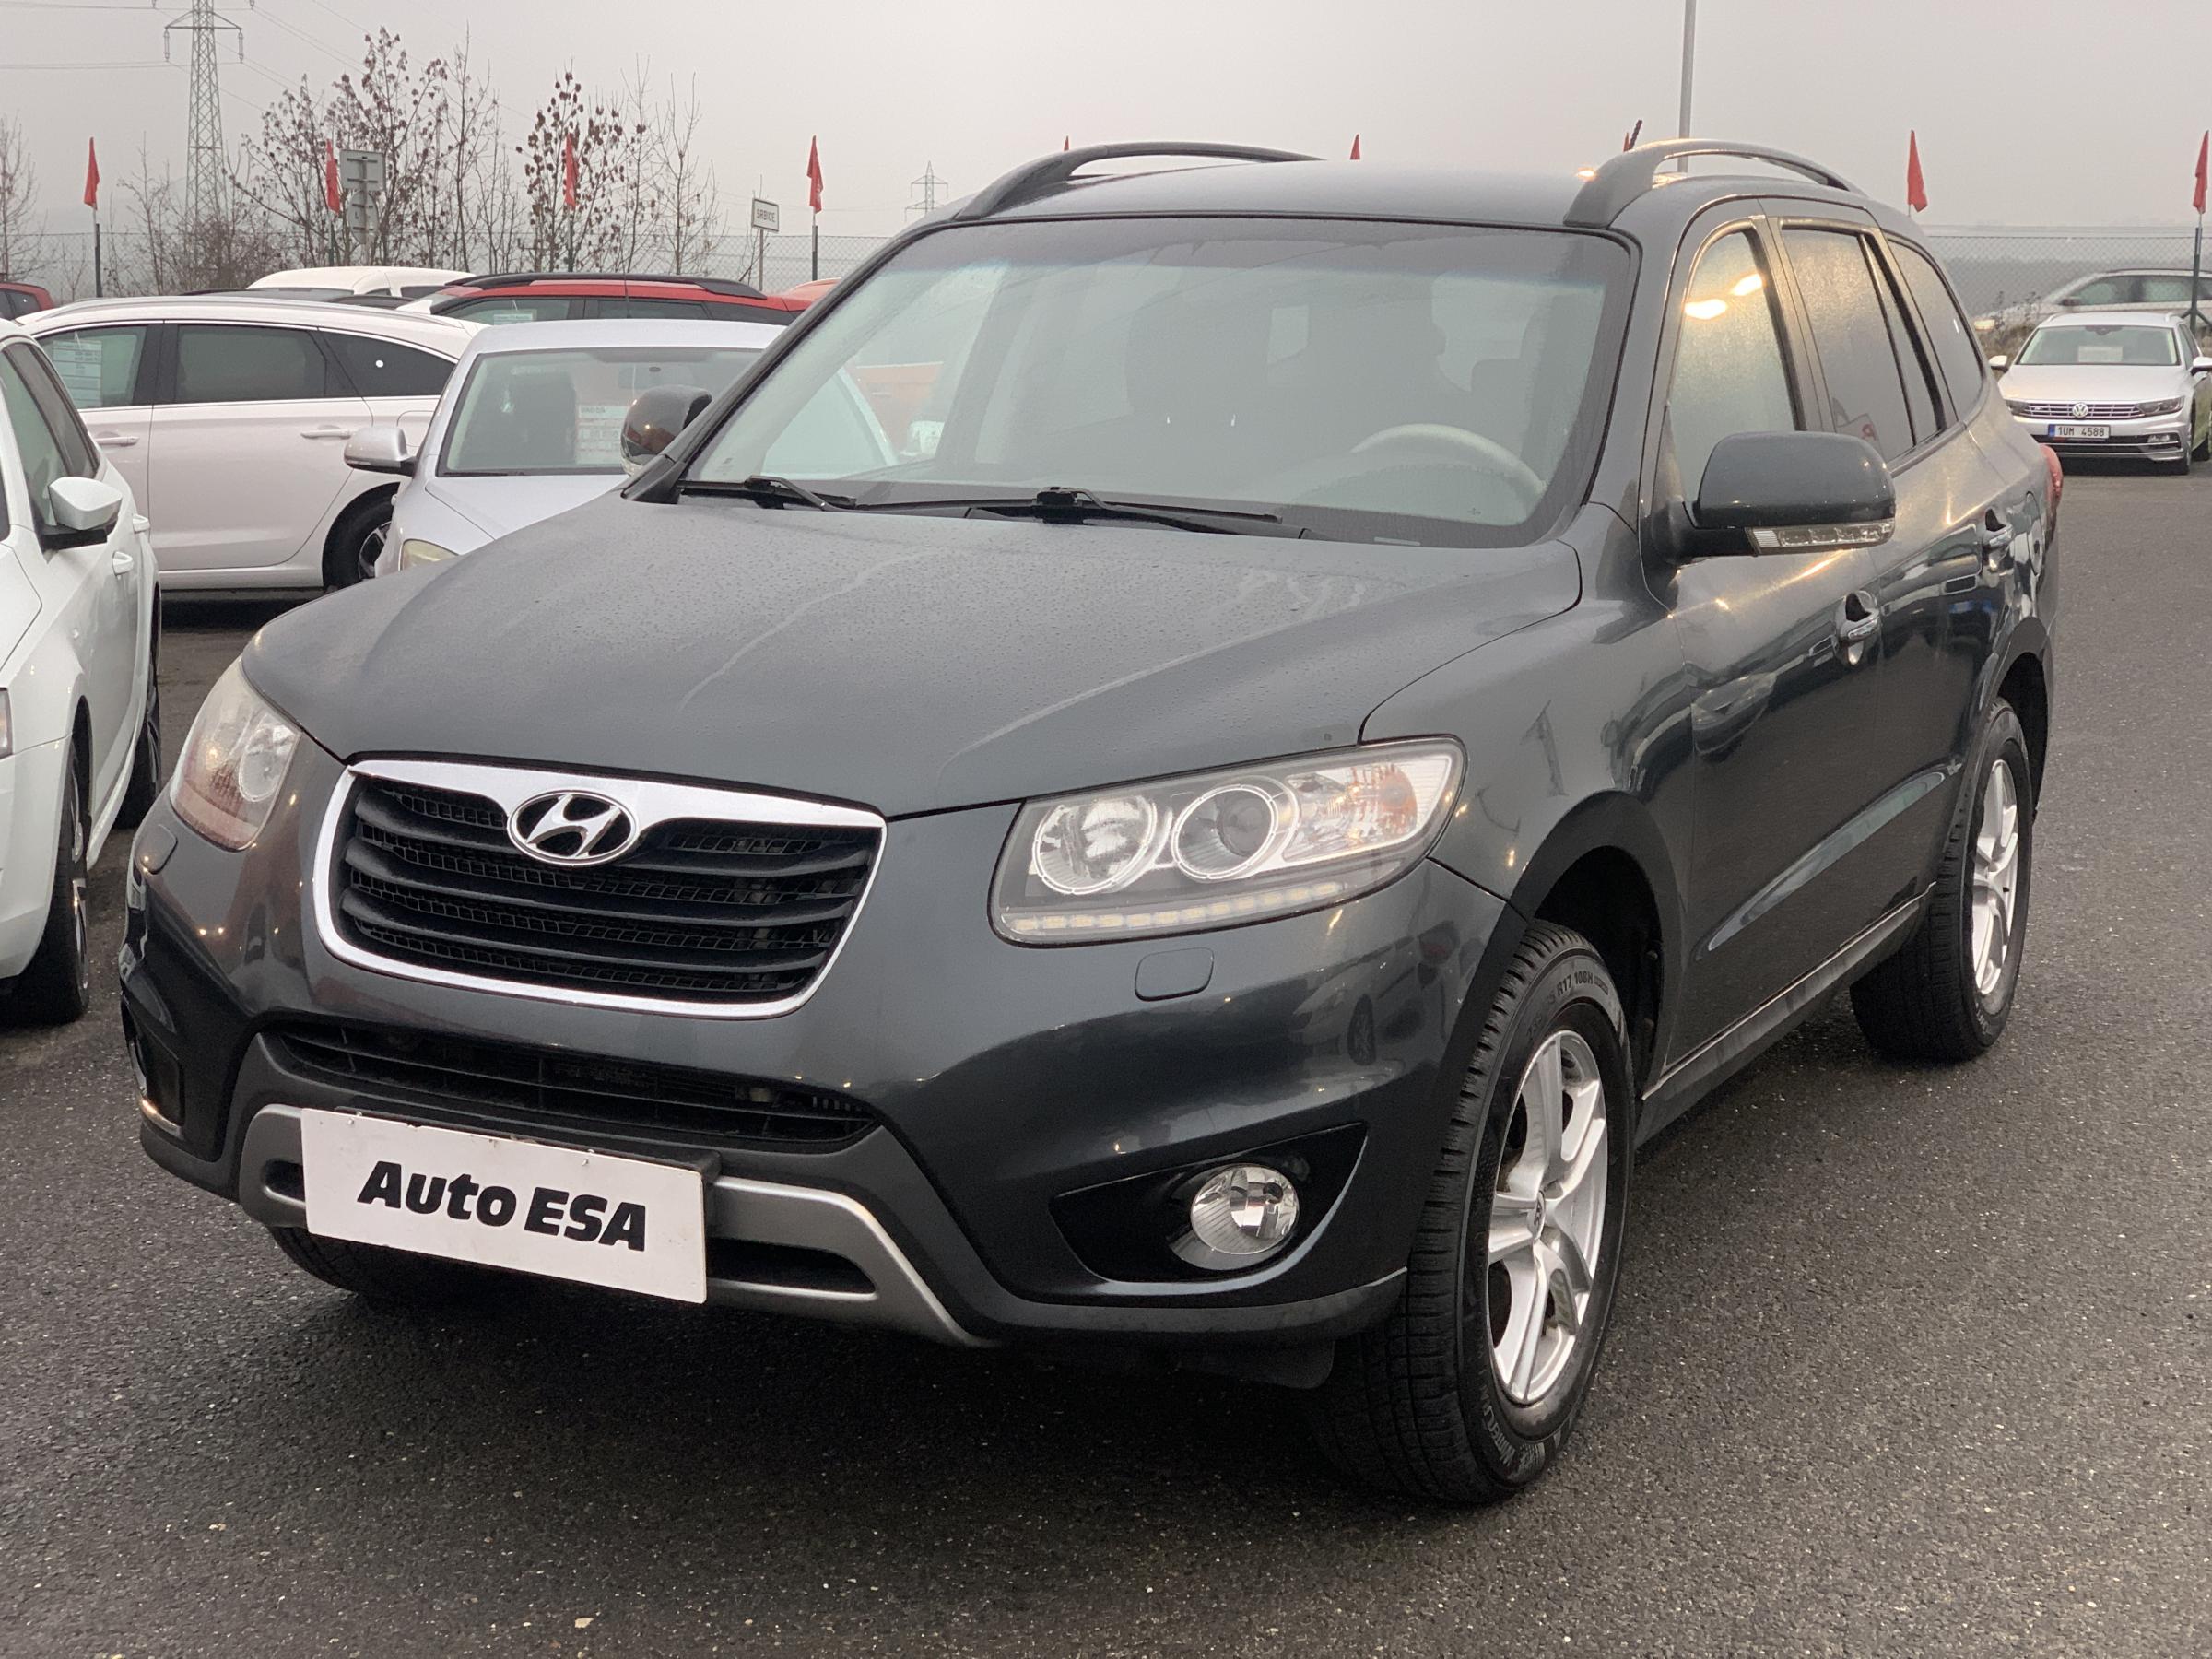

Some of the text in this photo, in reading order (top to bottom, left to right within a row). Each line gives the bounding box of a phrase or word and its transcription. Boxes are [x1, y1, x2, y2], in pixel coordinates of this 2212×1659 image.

[2058, 427, 2104, 436] 1UM 4588
[357, 1160, 646, 1252] Auto ESA
